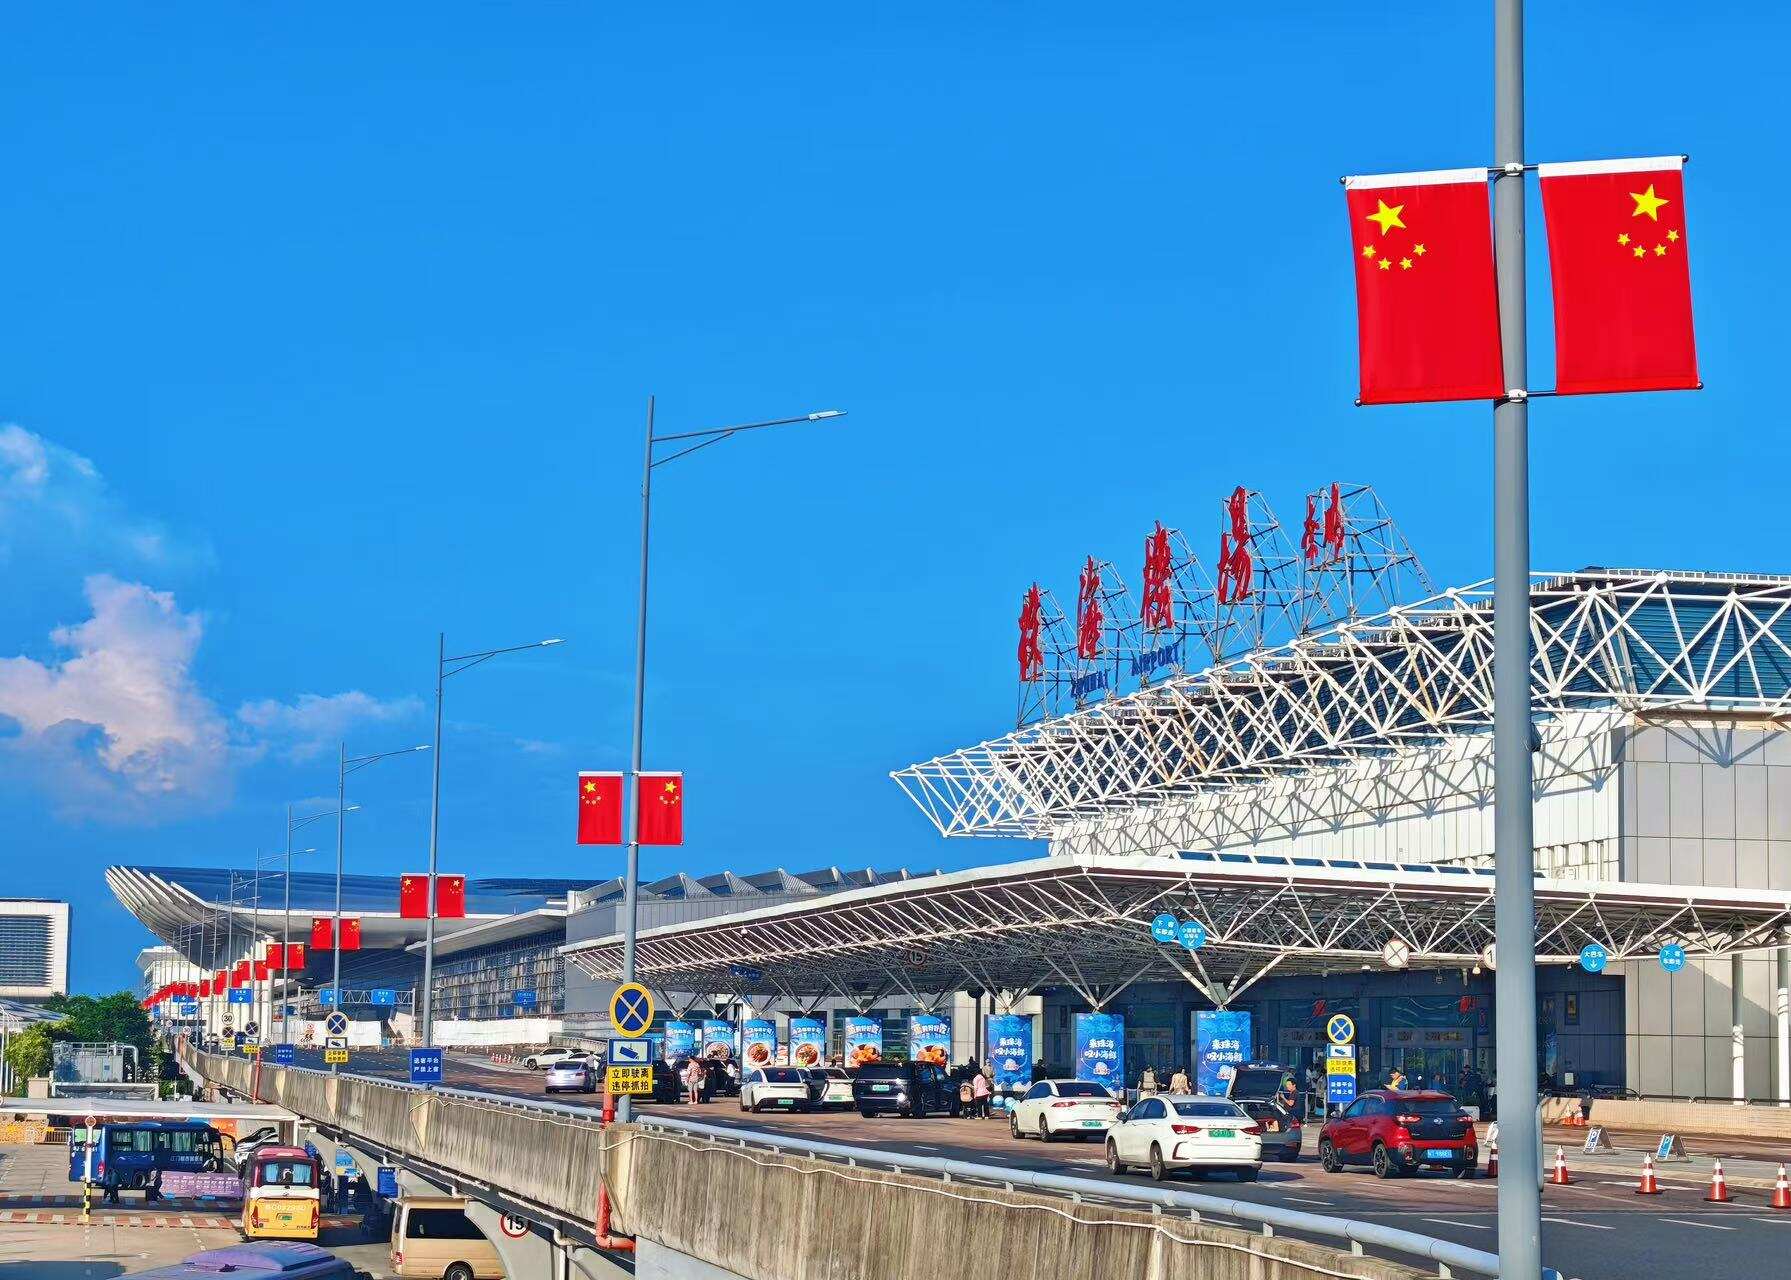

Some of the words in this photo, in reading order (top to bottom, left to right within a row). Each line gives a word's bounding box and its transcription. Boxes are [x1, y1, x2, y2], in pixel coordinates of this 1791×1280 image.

[1131, 643, 1180, 677] AIRPORT
[611, 1068, 649, 1079] 立即驶离
[611, 1080, 649, 1092] 违停抓拍
[507, 1215, 525, 1230] 15
